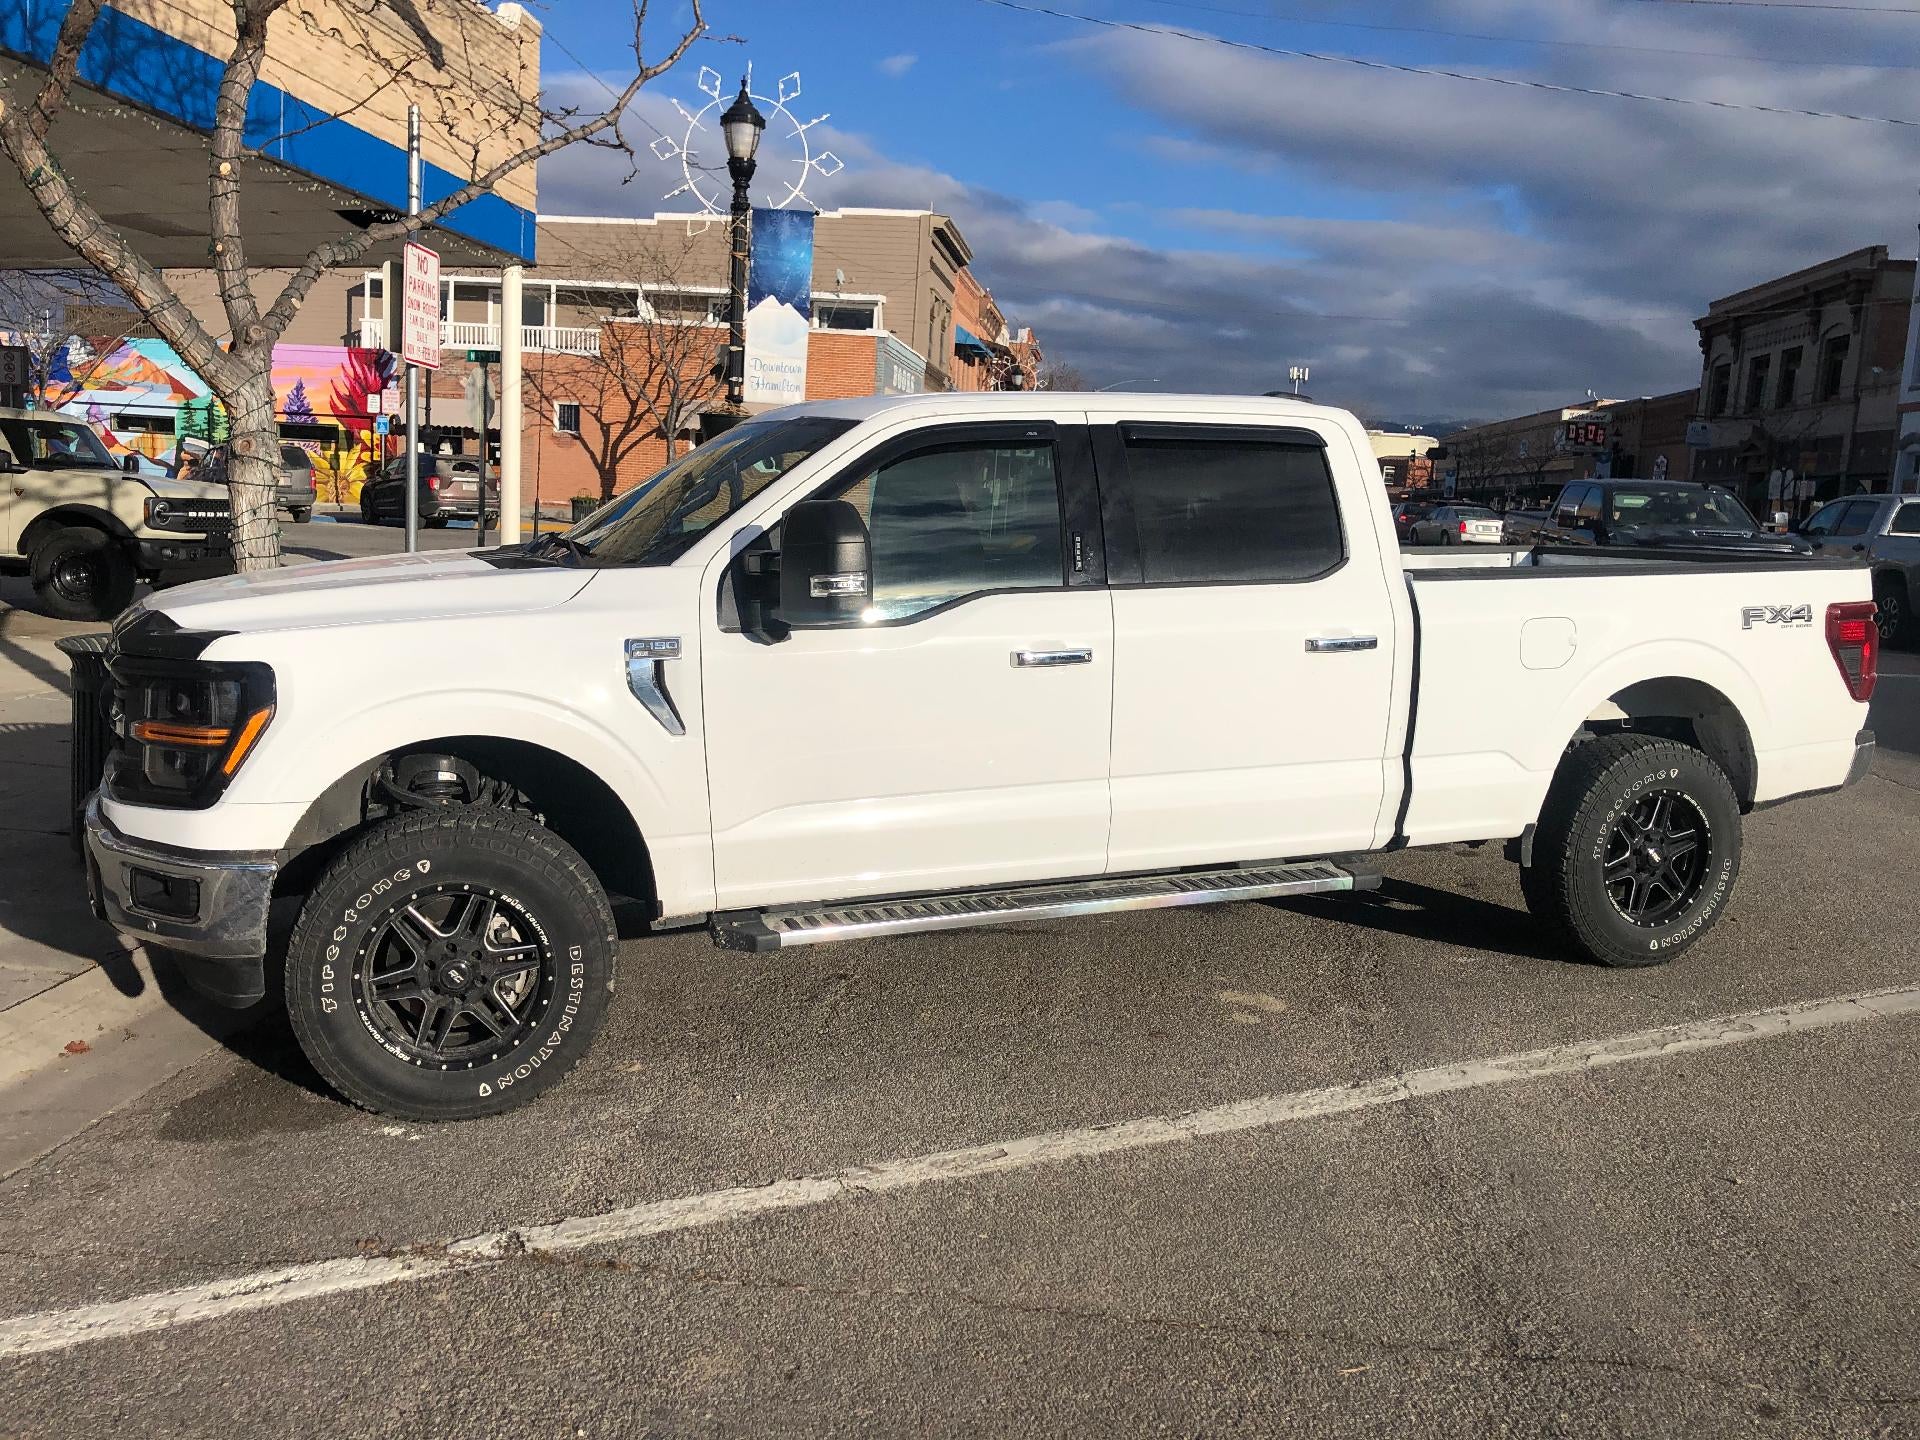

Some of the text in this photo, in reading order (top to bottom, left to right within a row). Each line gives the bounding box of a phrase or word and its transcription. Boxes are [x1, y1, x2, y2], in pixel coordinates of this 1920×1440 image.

[417, 253, 429, 275] NO
[408, 276, 436, 300] PARKING
[407, 296, 438, 319] SNOW ROUTE
[750, 358, 802, 374] Downtown
[750, 376, 801, 392] Hamilton
[1568, 424, 1605, 443] DRUG
[1741, 604, 1813, 630] FX4
[524, 912, 550, 946] COUNTRY
[359, 1010, 385, 1044] COUNTRY
[497, 945, 584, 1091] DESTINATION
